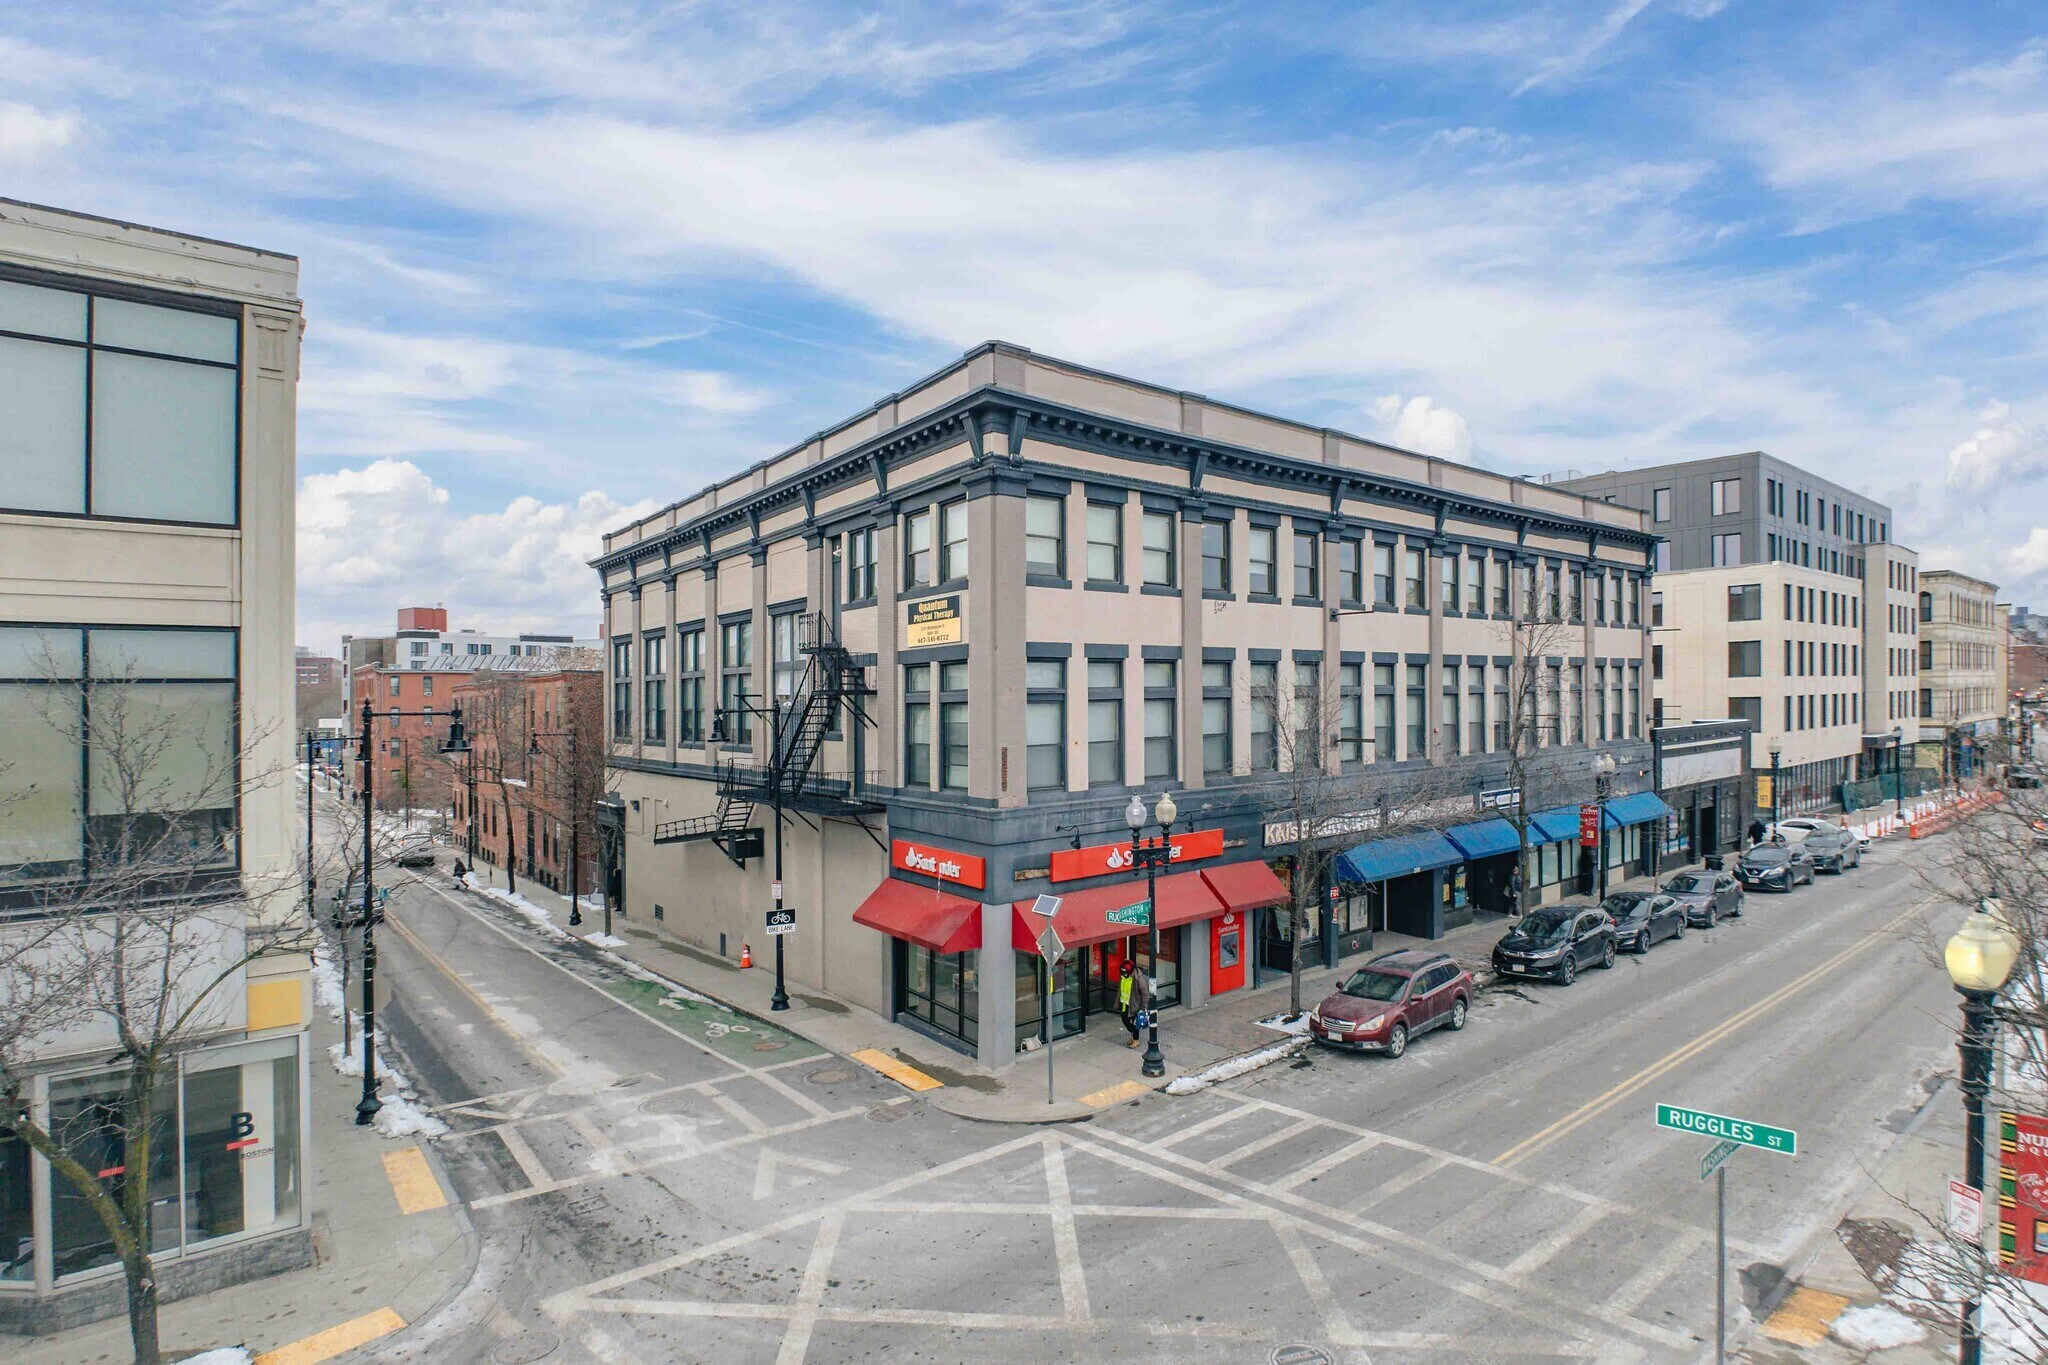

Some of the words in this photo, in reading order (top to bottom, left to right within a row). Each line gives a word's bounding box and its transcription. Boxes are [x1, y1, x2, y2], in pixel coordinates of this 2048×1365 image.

[918, 600, 948, 613] Quantum
[913, 612, 932, 623] Physical
[934, 610, 954, 619] Therapy
[915, 853, 961, 878] Santnder
[768, 926, 780, 934] BIKE
[781, 924, 794, 932] LANE
[1218, 923, 1240, 934] Santander
[231, 1112, 254, 1139] B
[1670, 1110, 1754, 1141] RUGGLES
[1767, 1135, 1783, 1147] ST
